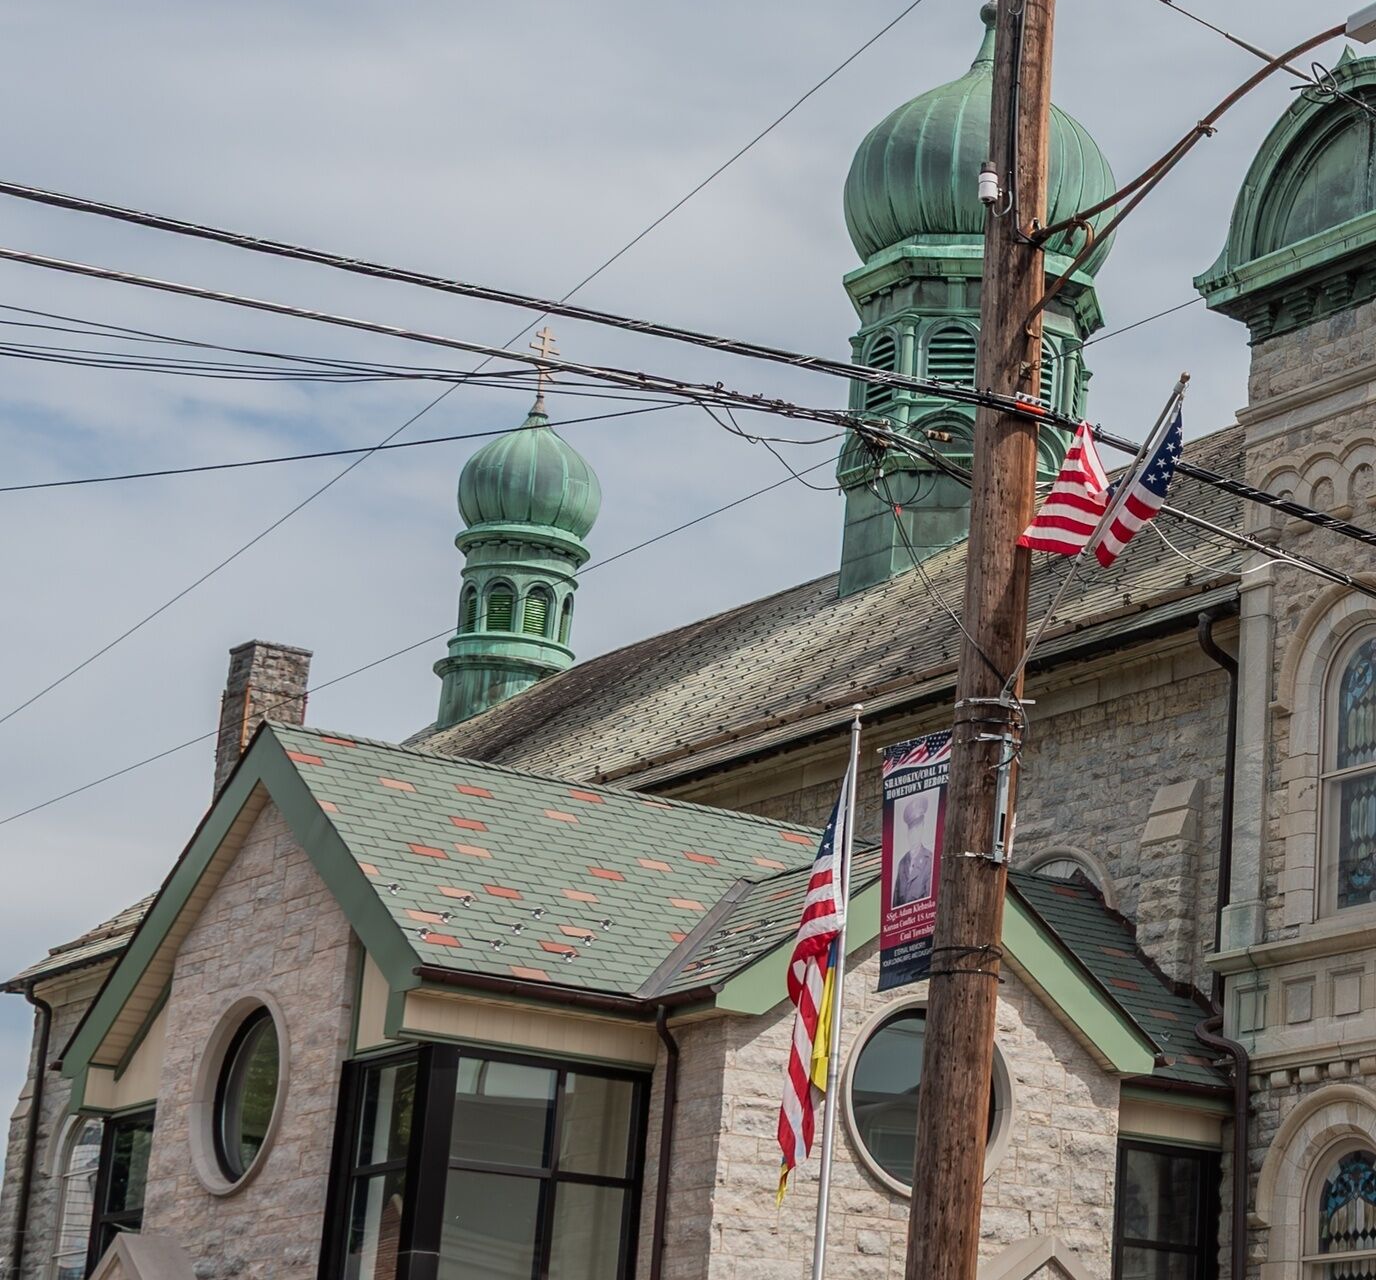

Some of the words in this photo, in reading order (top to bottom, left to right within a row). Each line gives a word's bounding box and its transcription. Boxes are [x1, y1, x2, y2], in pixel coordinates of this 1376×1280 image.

[884, 766, 936, 790] SHAMOKIN/COAL
[886, 781, 923, 800] HOMETOWN
[923, 774, 950, 790] HEROES
[900, 930, 912, 941] Coal
[912, 923, 935, 938] Township
